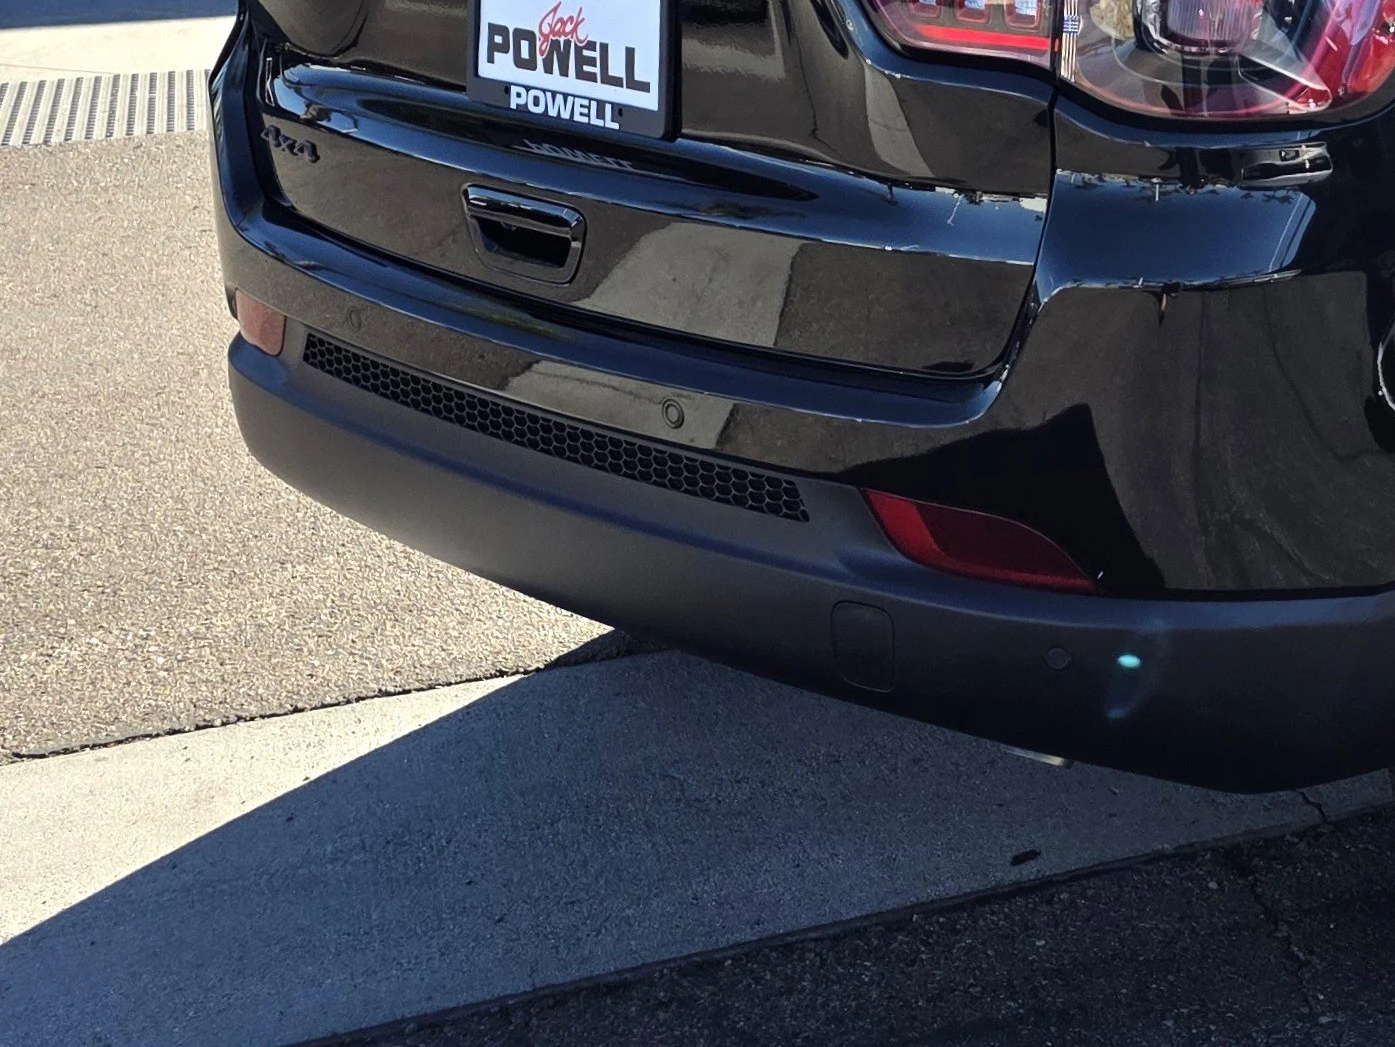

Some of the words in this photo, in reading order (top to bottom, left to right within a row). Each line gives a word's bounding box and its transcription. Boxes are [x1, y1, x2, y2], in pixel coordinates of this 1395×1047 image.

[538, 1, 589, 57] Jack
[487, 22, 652, 94] POWELL
[509, 85, 620, 130] POWELL
